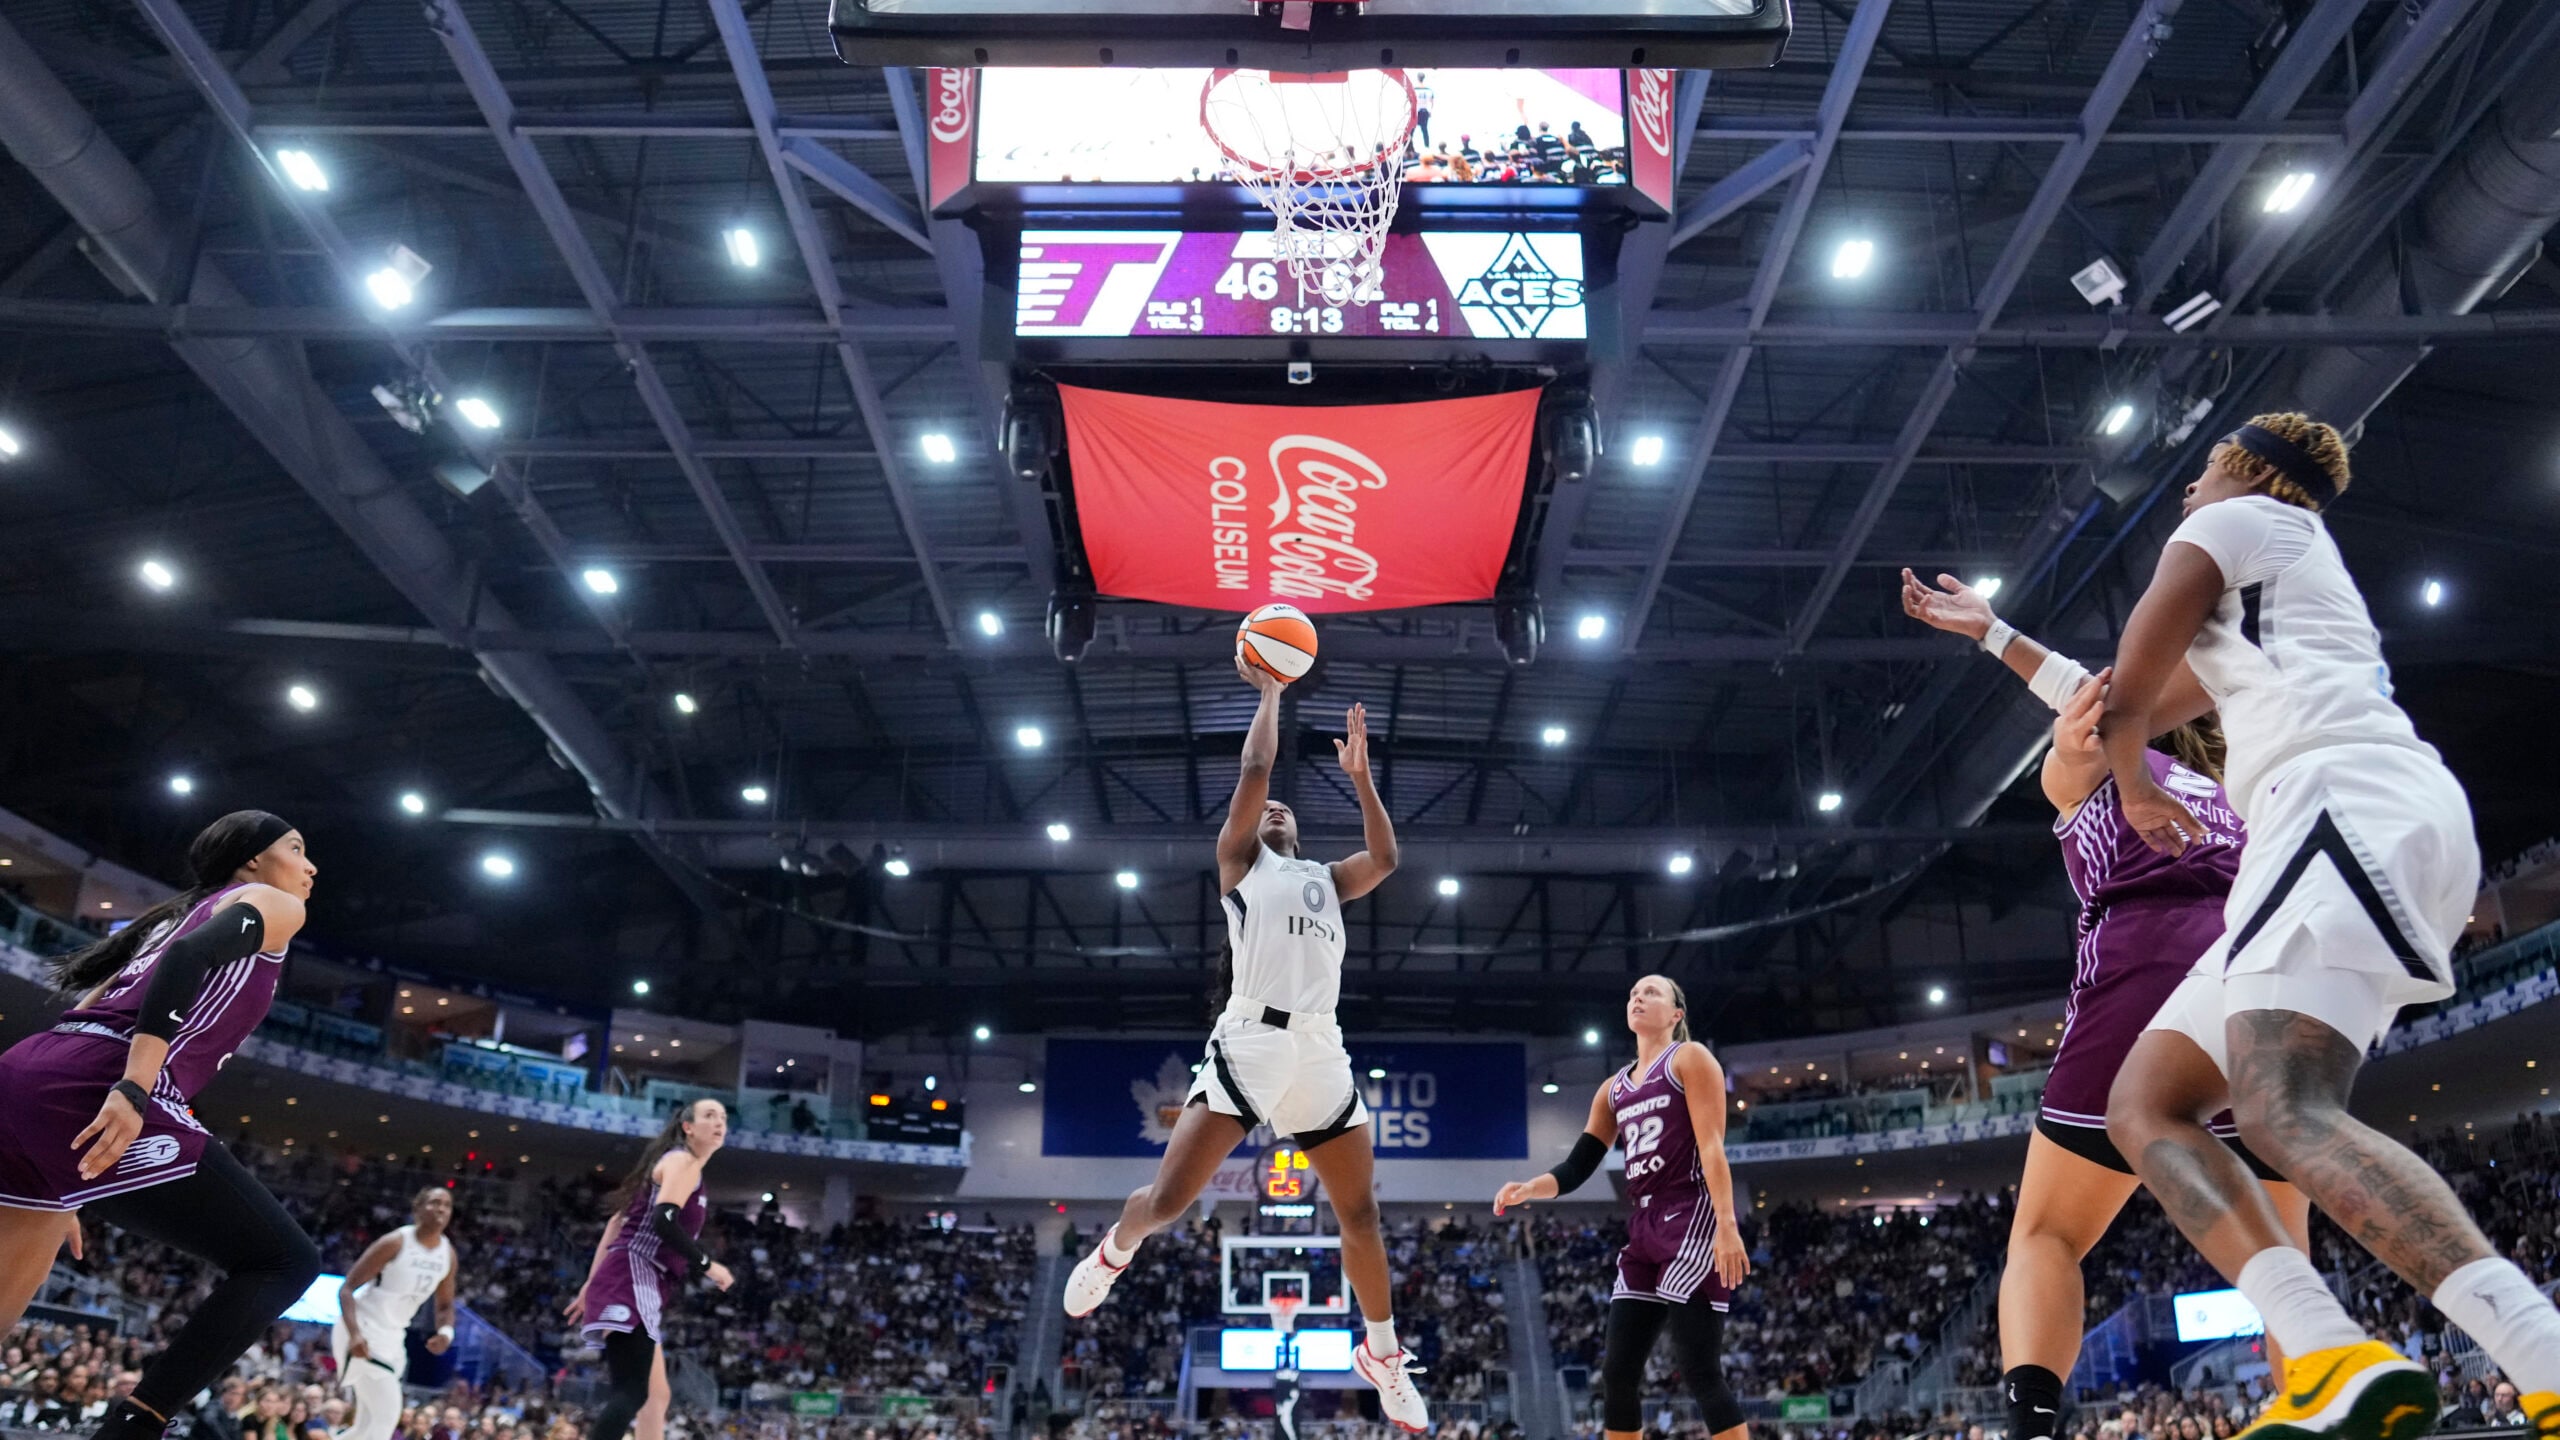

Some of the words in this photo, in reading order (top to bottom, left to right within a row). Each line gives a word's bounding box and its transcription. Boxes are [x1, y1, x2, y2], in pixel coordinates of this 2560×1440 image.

[1215, 262, 1279, 300] 46
[1458, 280, 1582, 305] ACES
[1191, 297, 1201, 314] 1
[1427, 298, 1437, 315] 1
[1189, 315, 1204, 332] 3
[1270, 307, 1344, 333] 8:13
[1425, 316, 1439, 333] 4
[1209, 456, 1249, 590] COLISEUM
[1303, 881, 1326, 913] 0
[1624, 1115, 1664, 1161] 22
